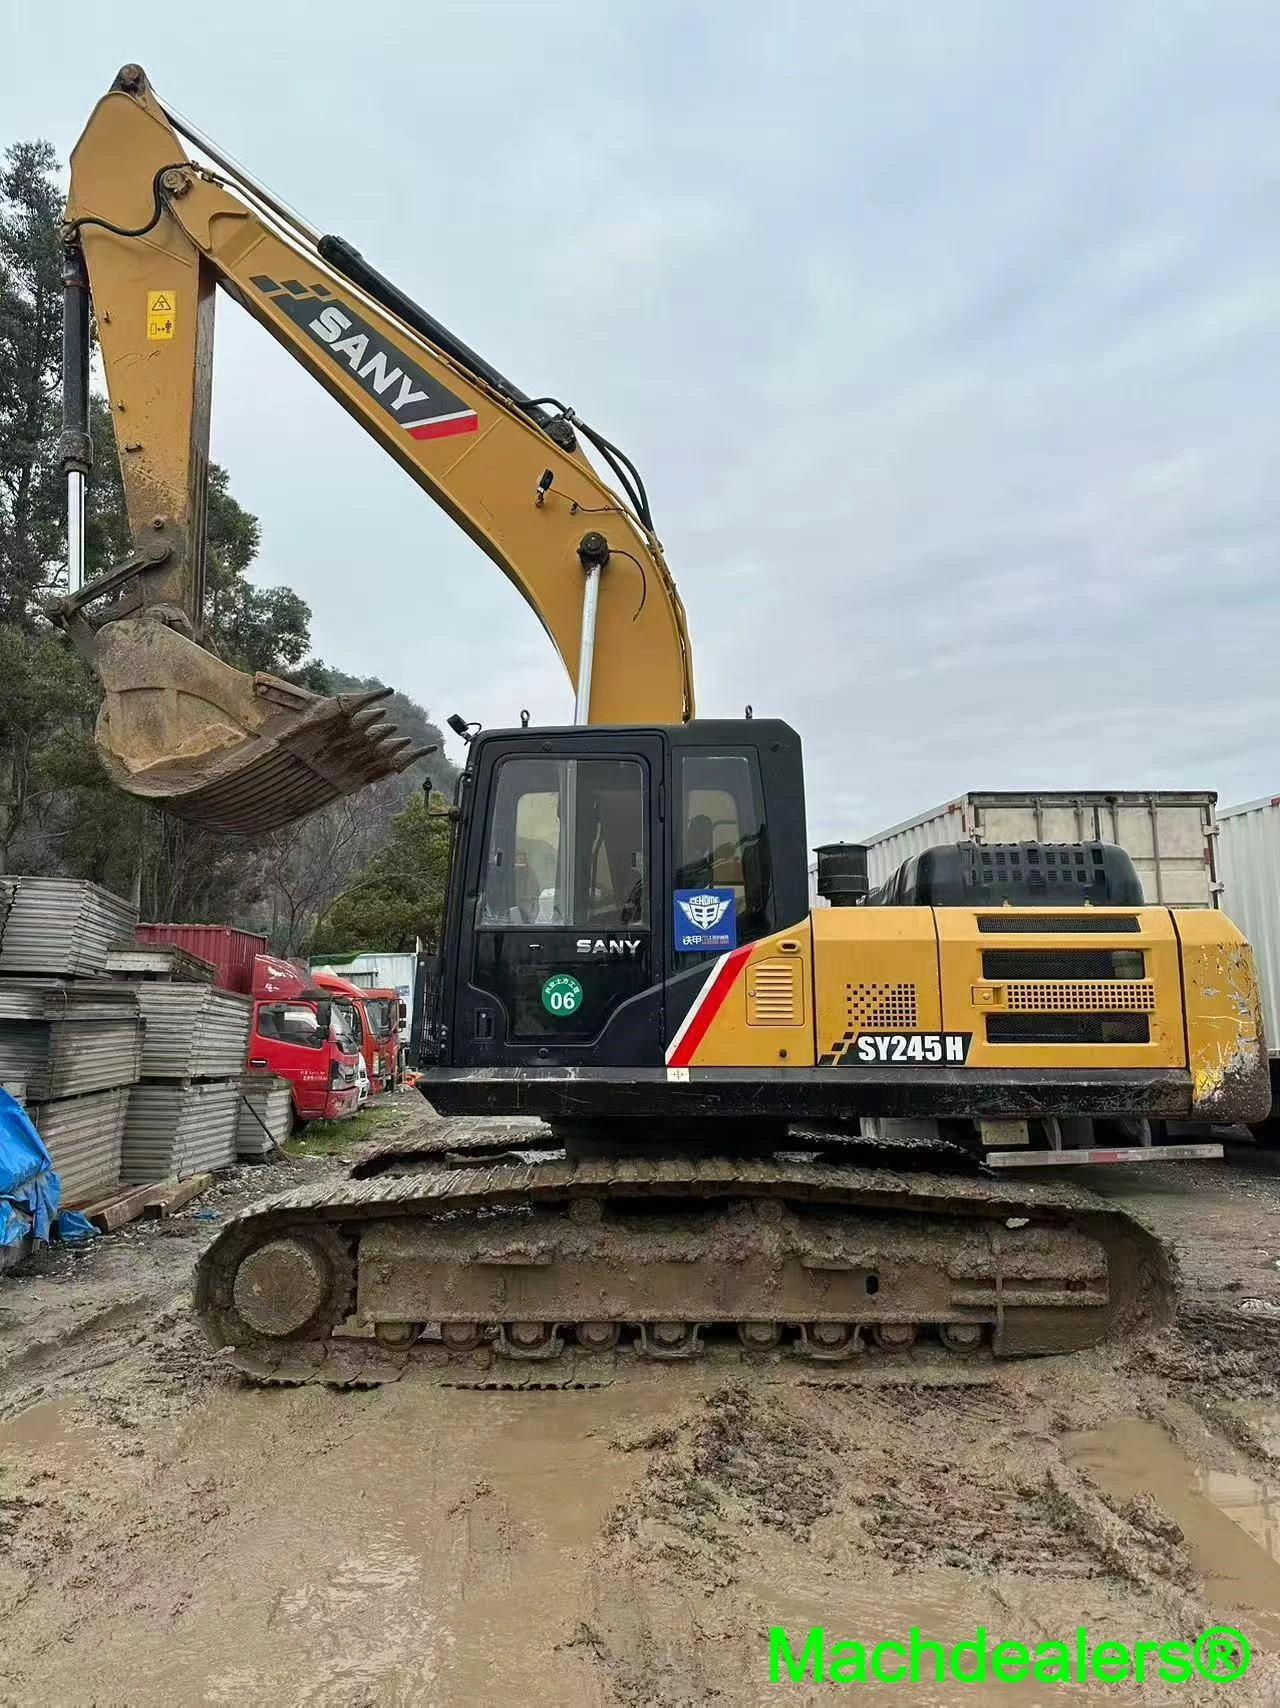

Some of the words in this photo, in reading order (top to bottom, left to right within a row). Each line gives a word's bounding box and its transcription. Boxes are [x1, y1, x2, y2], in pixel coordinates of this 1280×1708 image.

[308, 306, 430, 411] SANY
[576, 939, 641, 954] SANY
[682, 935, 702, 946] 铁甲
[550, 991, 576, 1011] 06
